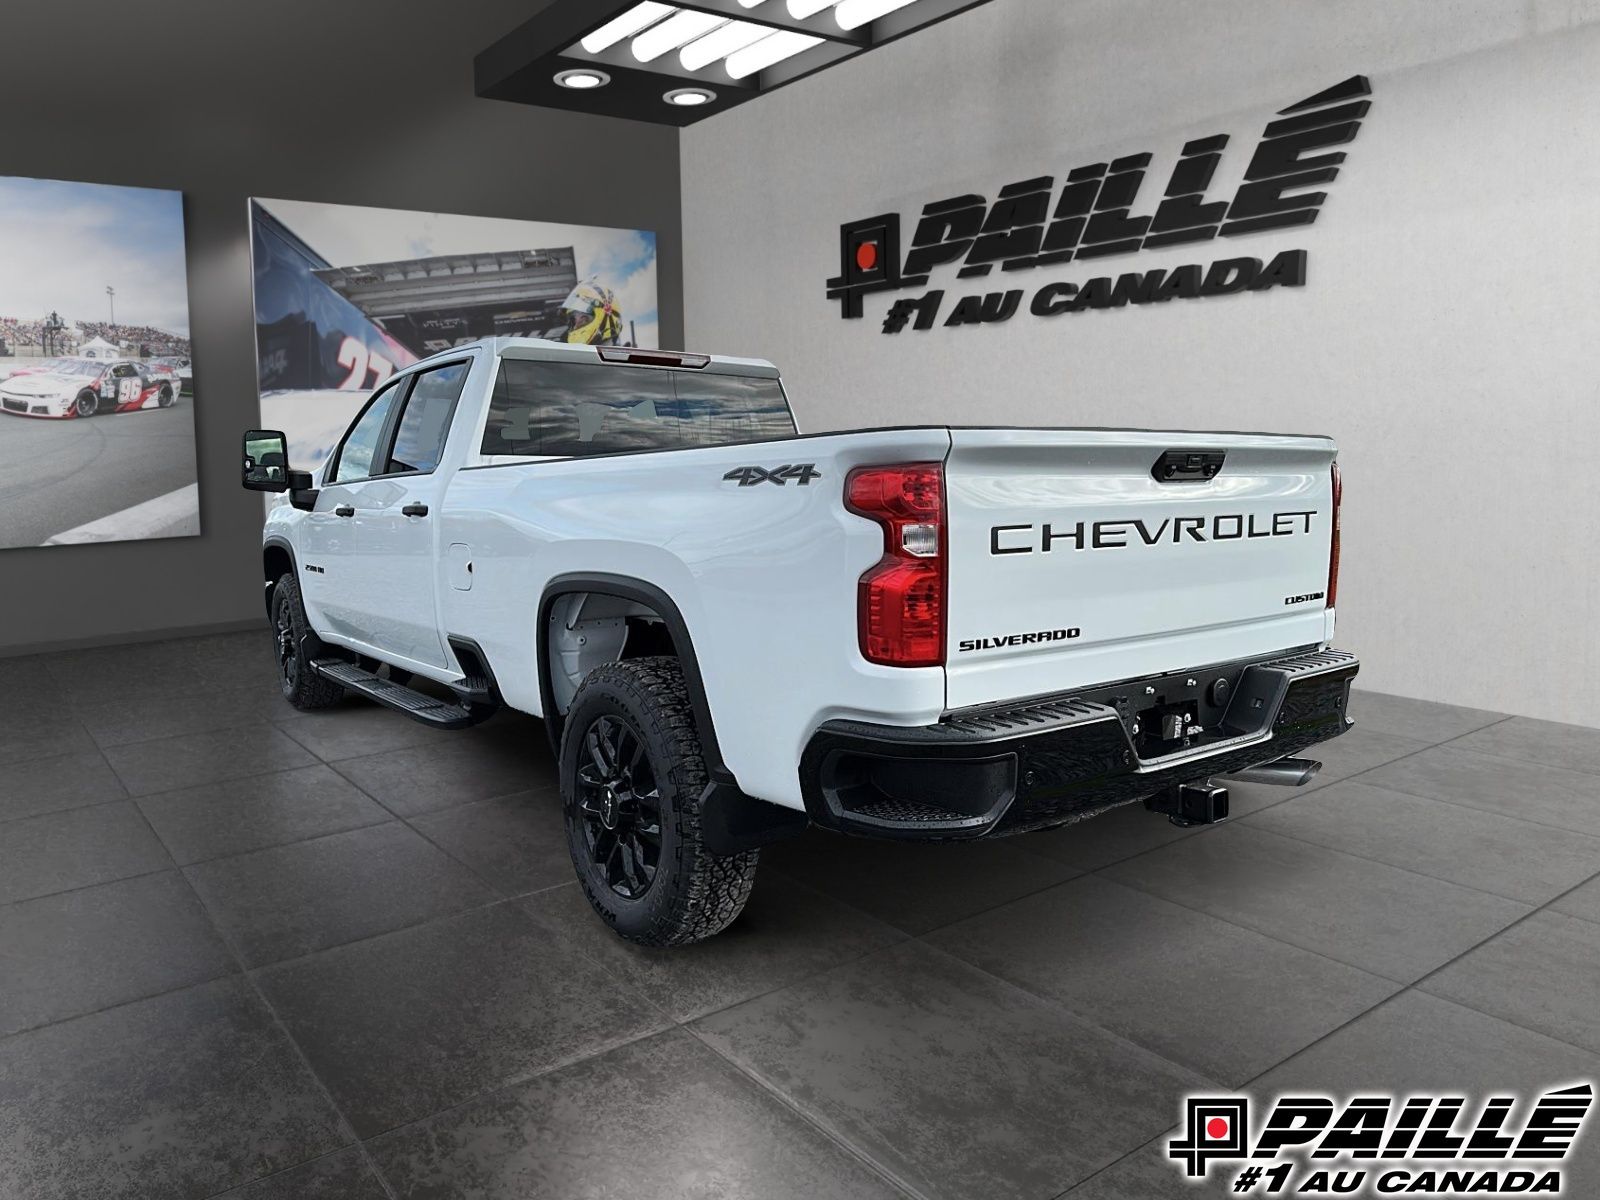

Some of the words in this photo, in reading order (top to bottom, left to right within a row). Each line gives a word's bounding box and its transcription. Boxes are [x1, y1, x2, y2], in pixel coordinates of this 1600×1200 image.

[881, 290, 945, 334] #1
[943, 289, 1024, 327] AU
[1029, 249, 1308, 317] CANADA
[337, 336, 393, 391] 27
[118, 378, 143, 403] 96
[990, 510, 1318, 556] CHEVROLET
[1284, 591, 1325, 605] CUSTOM
[958, 627, 1081, 652] SILVERADO
